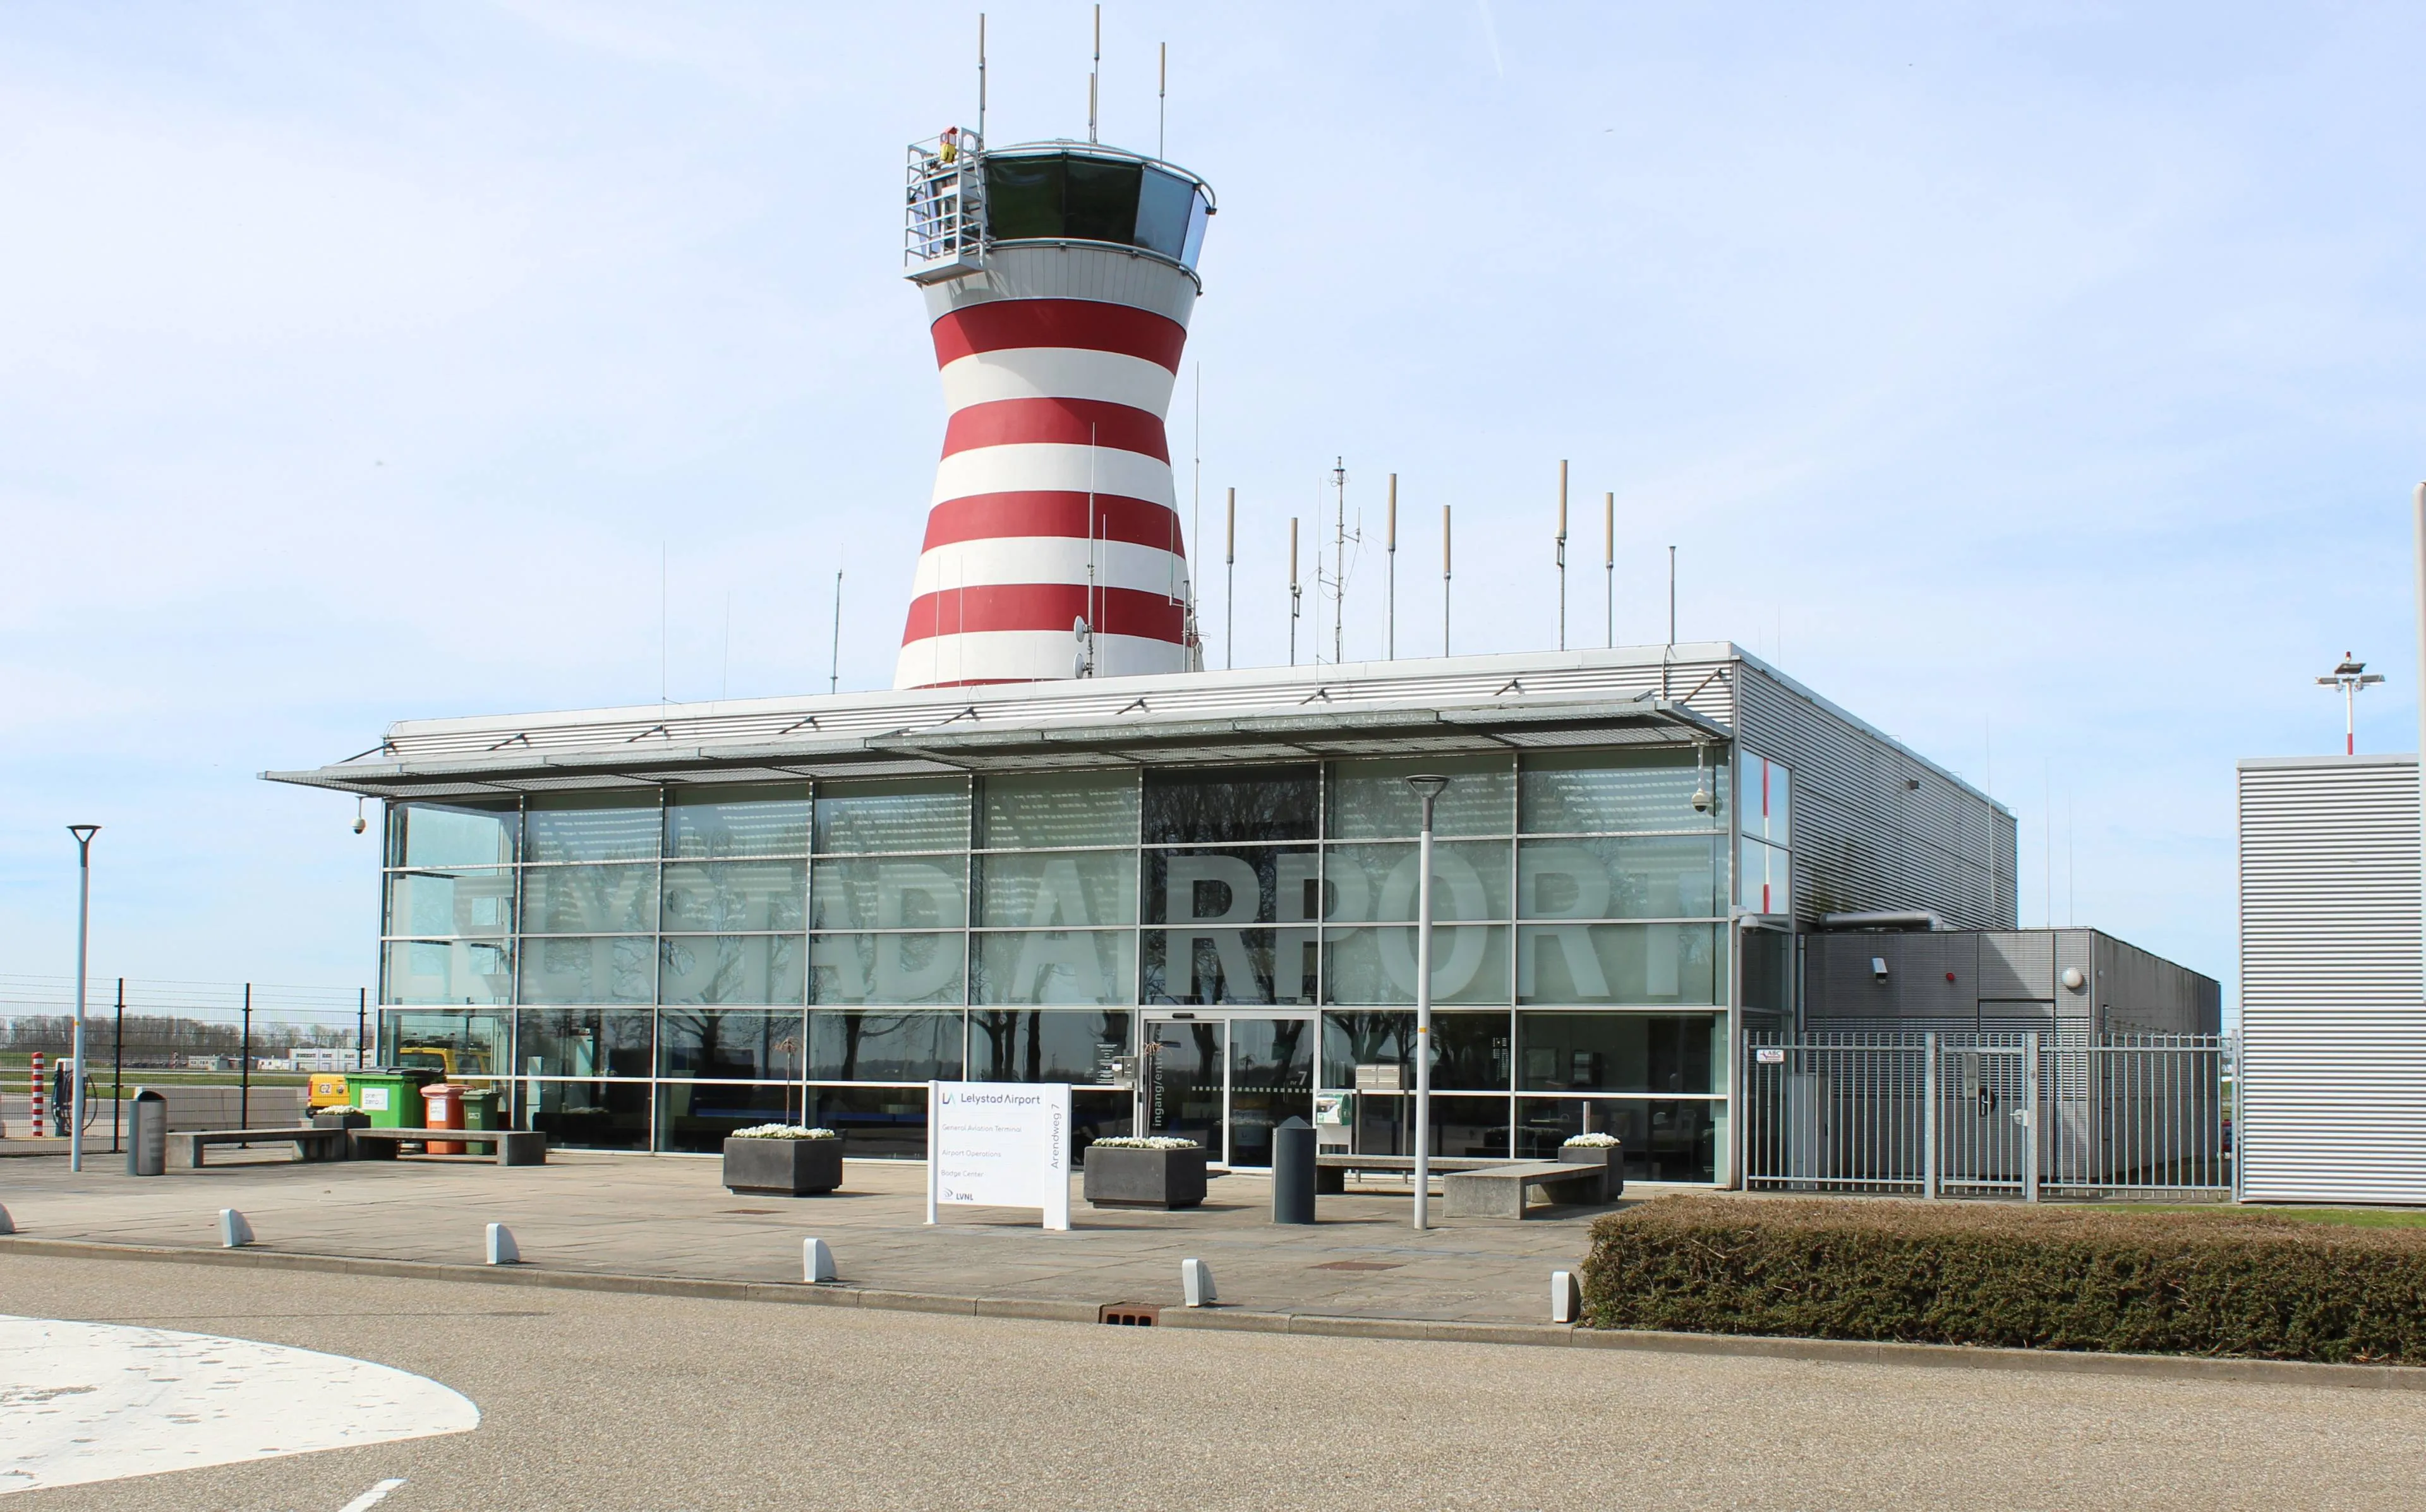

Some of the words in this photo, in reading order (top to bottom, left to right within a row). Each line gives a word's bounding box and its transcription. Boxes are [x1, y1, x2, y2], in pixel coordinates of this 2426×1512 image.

[390, 863, 964, 999] LELYSTAD
[1011, 846, 1709, 1000] AIRPORT
[1298, 1071, 1308, 1086] 7
[961, 1093, 1003, 1105] Lelystad
[1004, 1094, 1041, 1106] Airport
[1051, 1113, 1062, 1169] Arendweg
